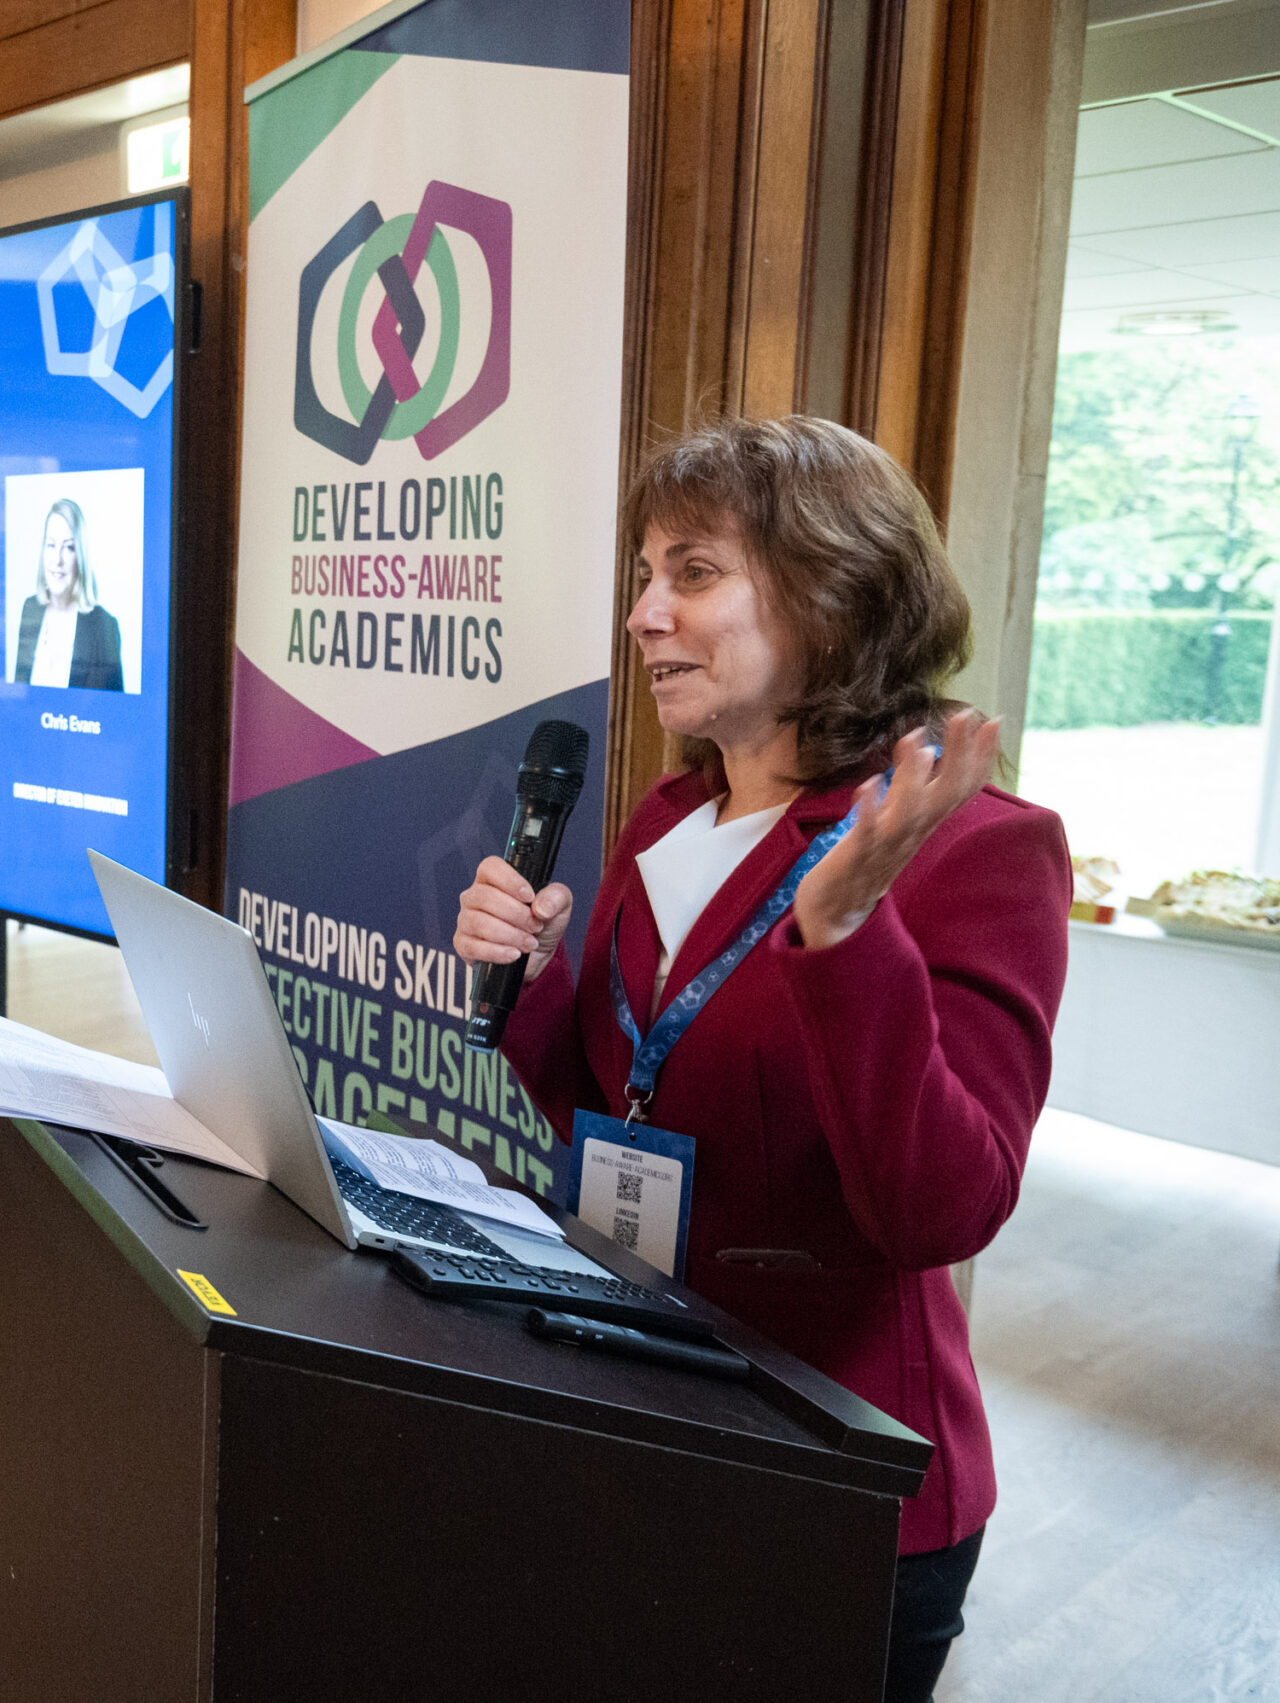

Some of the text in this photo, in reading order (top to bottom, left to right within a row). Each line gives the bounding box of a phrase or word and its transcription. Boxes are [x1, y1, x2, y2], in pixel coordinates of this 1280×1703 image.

[293, 472, 503, 542] DEVELOPING
[291, 554, 502, 603] BUSINESS-AWARE
[287, 608, 502, 683] ACADEMICS
[40, 712, 101, 735] Chris Evans
[238, 887, 387, 991] DEVELOPING
